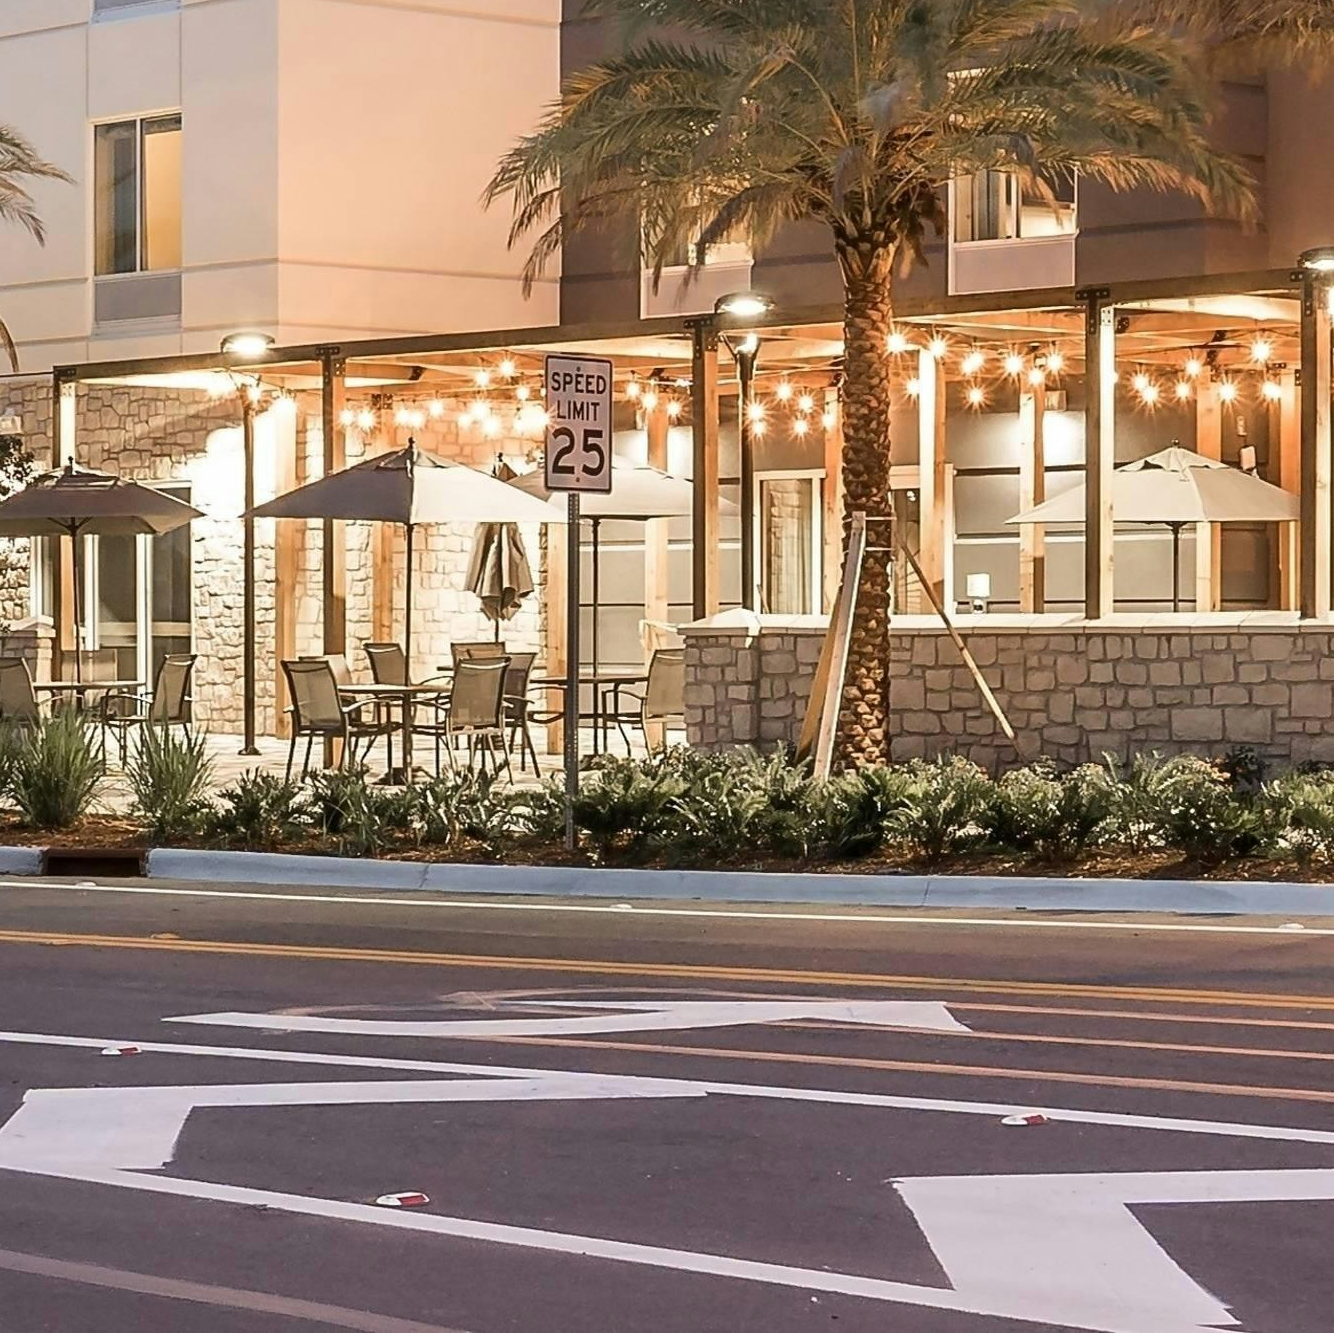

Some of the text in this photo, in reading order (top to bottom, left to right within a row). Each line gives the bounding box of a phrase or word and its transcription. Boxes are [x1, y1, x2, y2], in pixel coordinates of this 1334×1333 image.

[551, 371, 607, 395] SPEED
[556, 399, 601, 422] LIMIT
[551, 426, 606, 477] 25
